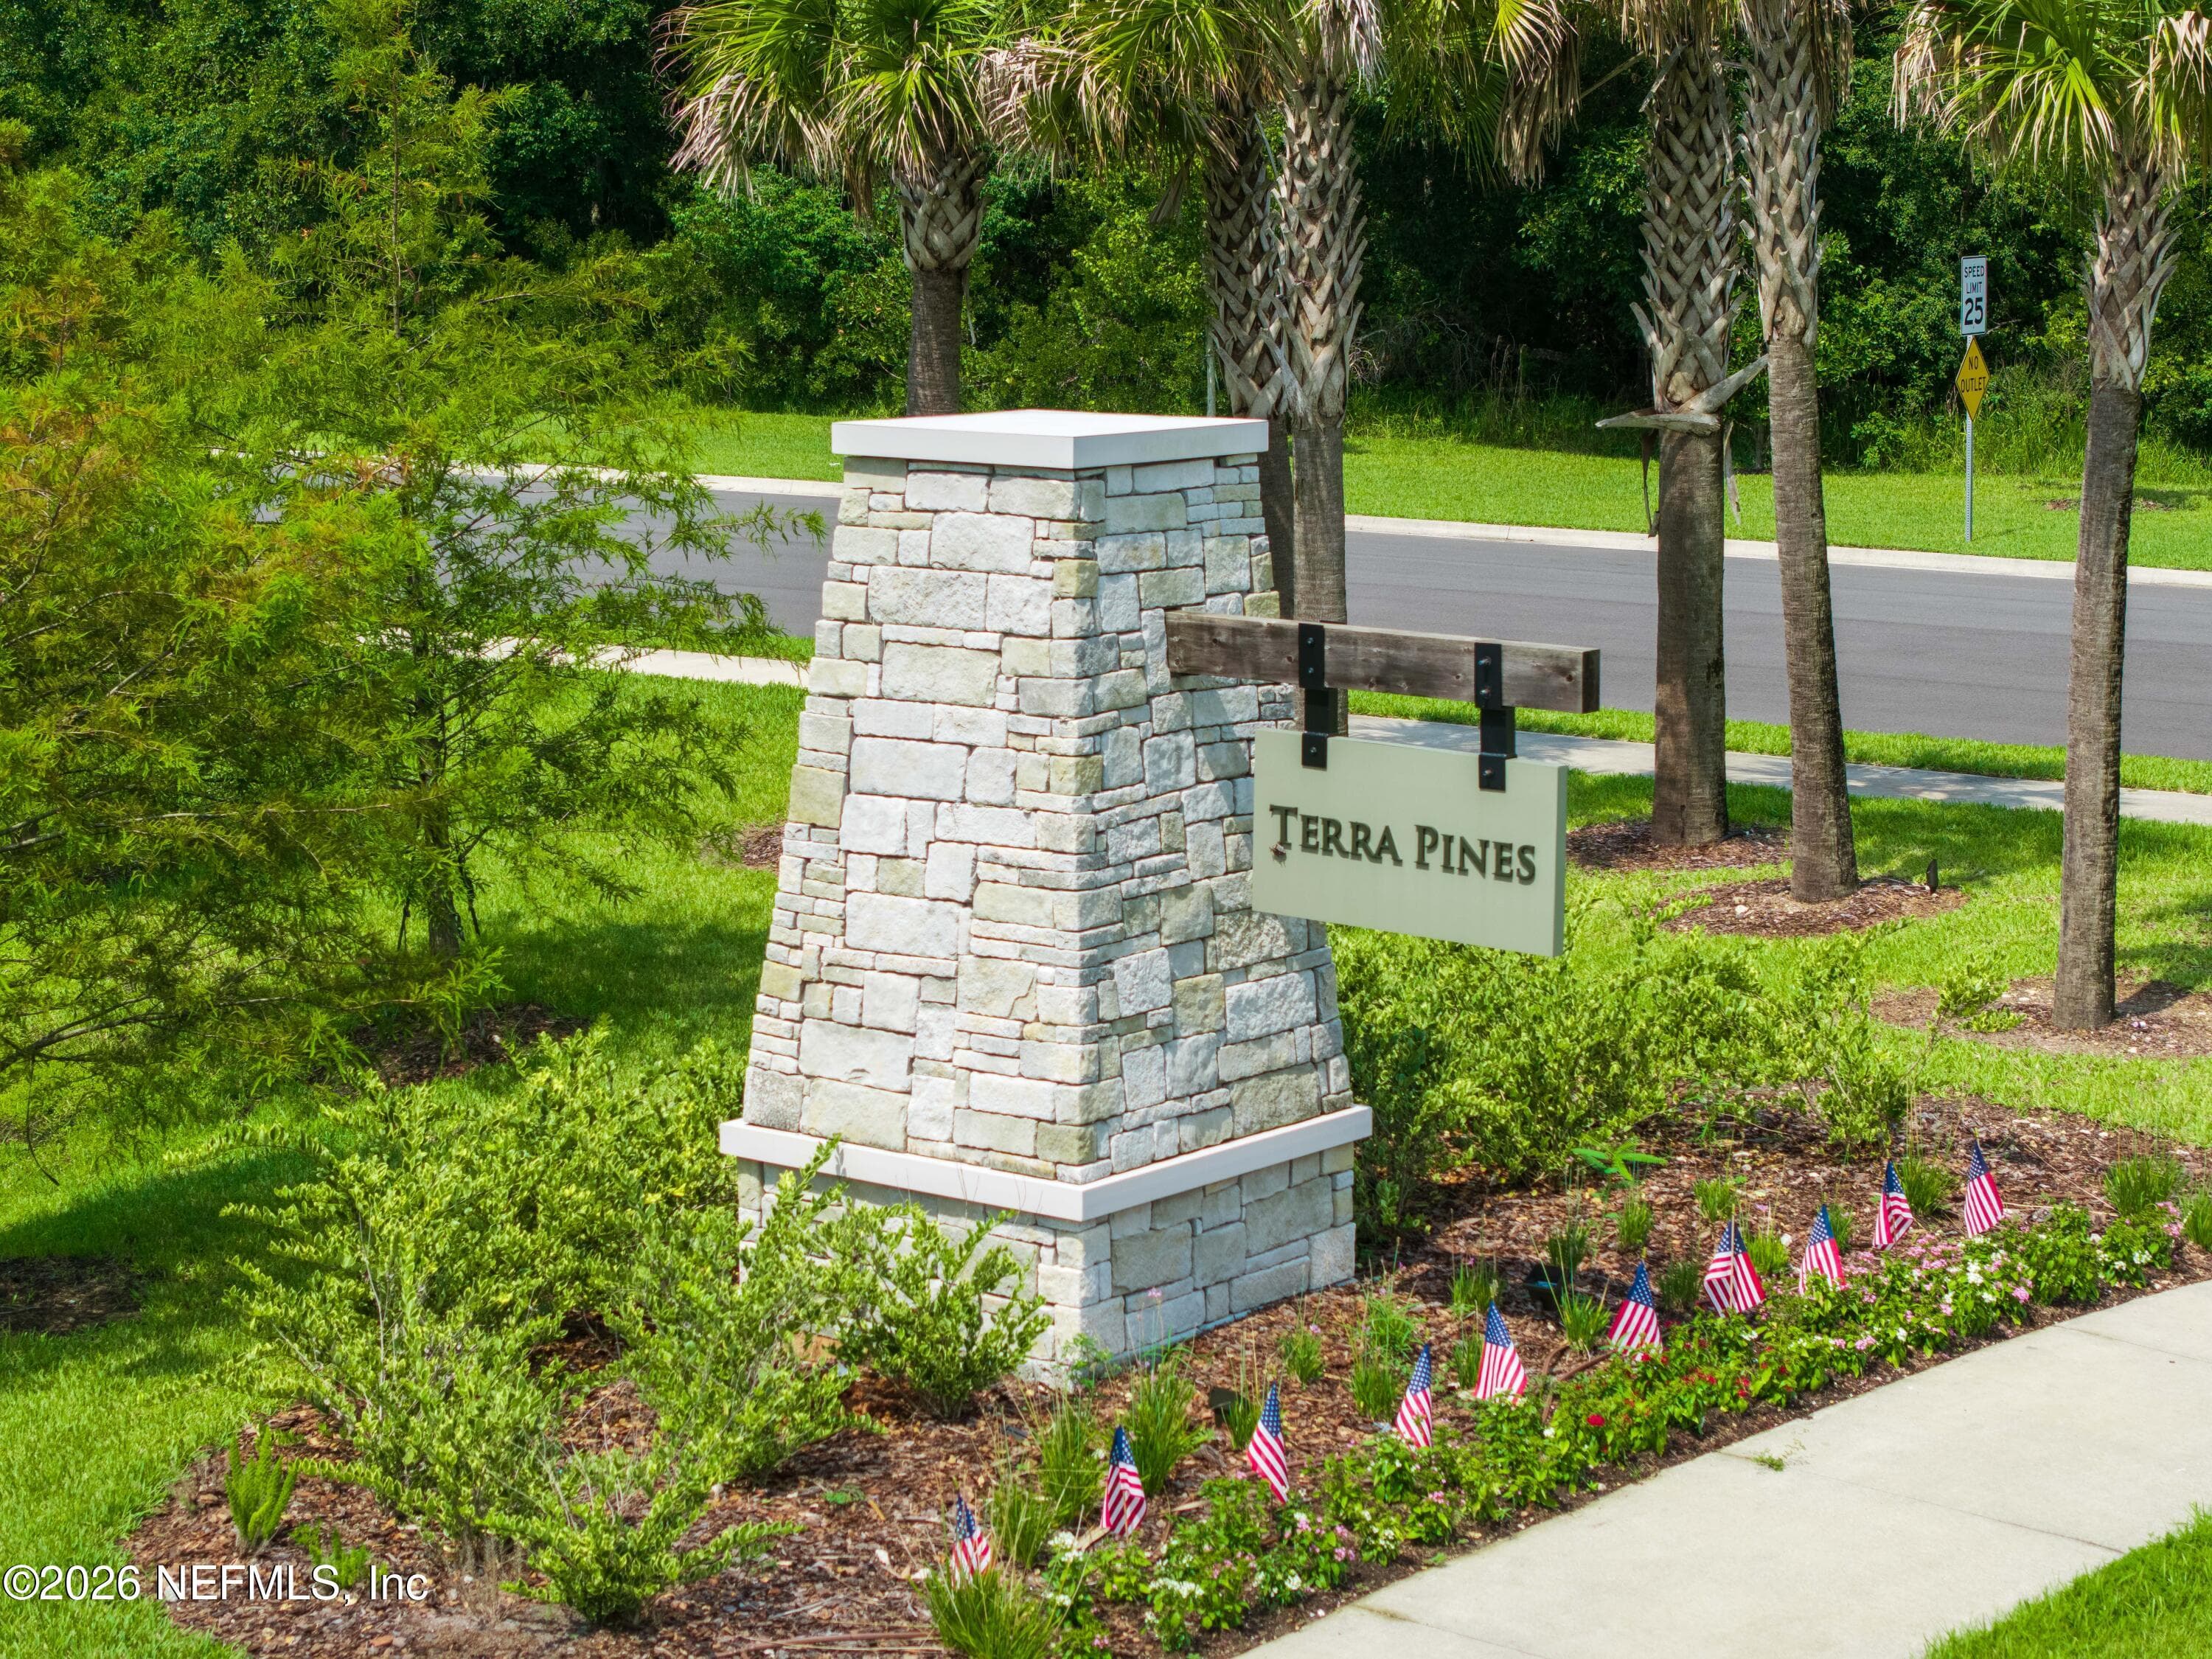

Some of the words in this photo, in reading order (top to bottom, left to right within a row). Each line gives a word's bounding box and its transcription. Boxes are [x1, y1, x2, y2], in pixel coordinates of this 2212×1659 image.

[1964, 265, 1984, 278] SPEED
[1966, 281, 1983, 294] LIMIT
[1964, 296, 1983, 326] 25
[1969, 355, 1979, 370] NO
[1961, 376, 1986, 393] OUTLET
[1269, 804, 1402, 866] TERRA
[1414, 824, 1536, 883] PINES
